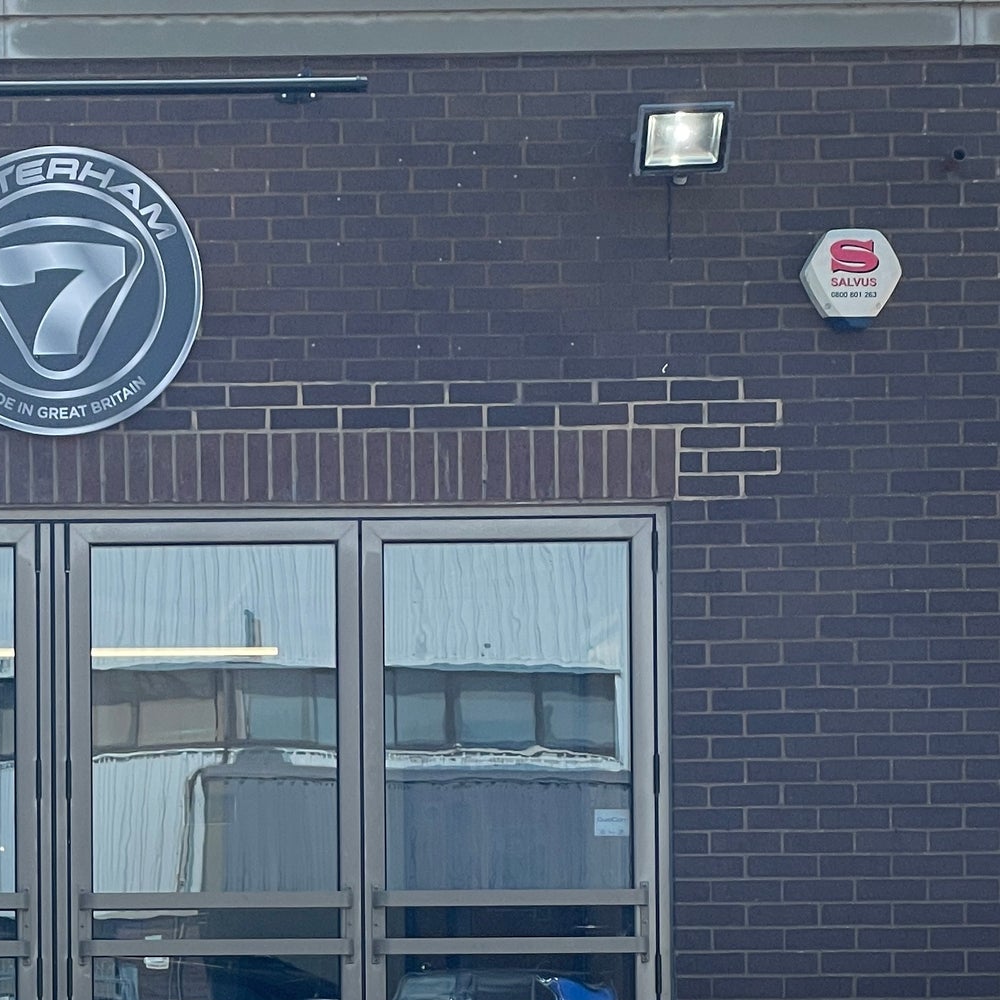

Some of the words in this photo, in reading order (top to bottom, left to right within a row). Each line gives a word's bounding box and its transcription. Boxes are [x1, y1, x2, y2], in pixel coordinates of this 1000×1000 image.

[831, 278, 877, 287] SALVUS
[17, 403, 34, 417] IN
[37, 404, 87, 420] GREAT
[91, 375, 147, 414] BRITAIN
